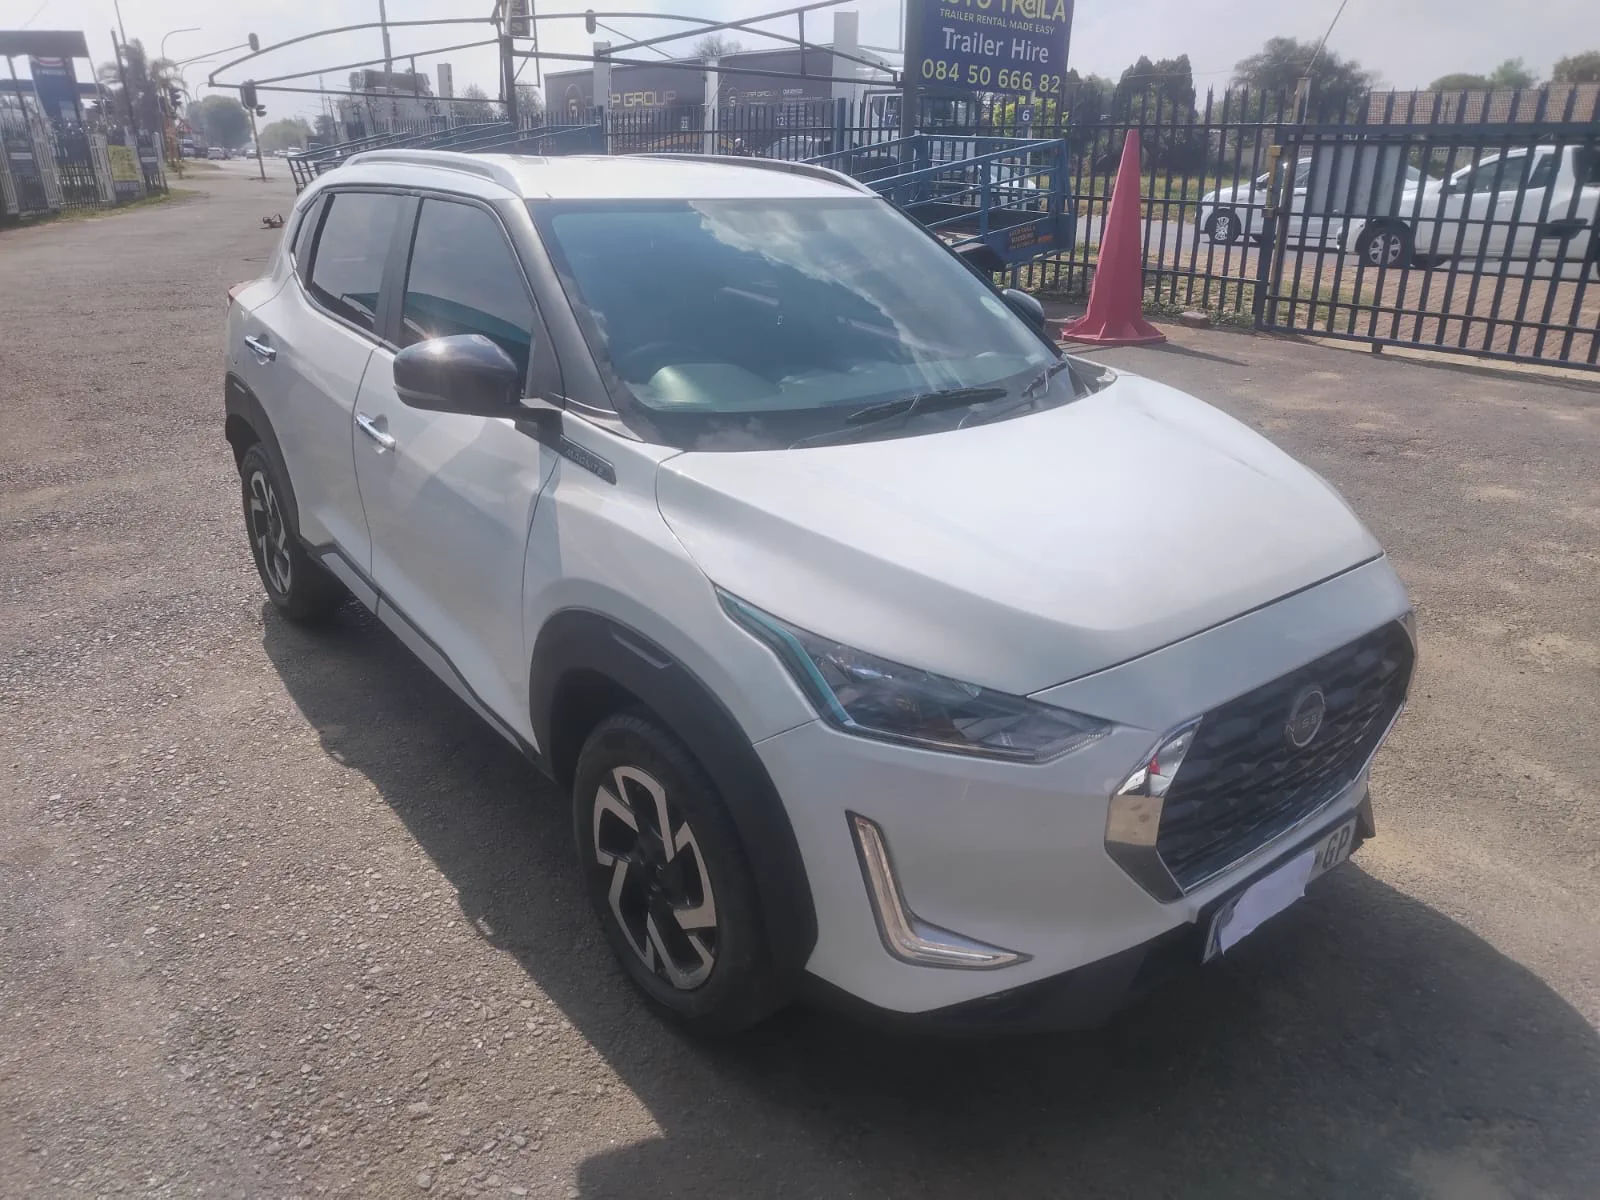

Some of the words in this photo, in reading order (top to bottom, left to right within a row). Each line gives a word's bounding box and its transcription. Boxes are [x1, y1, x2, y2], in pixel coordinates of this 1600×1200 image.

[940, 9, 974, 22] TRAILER
[976, 14, 1007, 28] RENTAL
[1010, 21, 1033, 32] MADE
[1035, 25, 1055, 35] EASY
[942, 27, 1004, 57] Trailer
[1011, 37, 1049, 63] Hire
[922, 58, 960, 82] 084
[967, 64, 991, 86] 50
[998, 68, 1033, 91] 666
[1039, 73, 1061, 94] 82
[624, 90, 676, 107] GROUP
[1022, 109, 1030, 121] 6
[1322, 825, 1350, 868] GP
